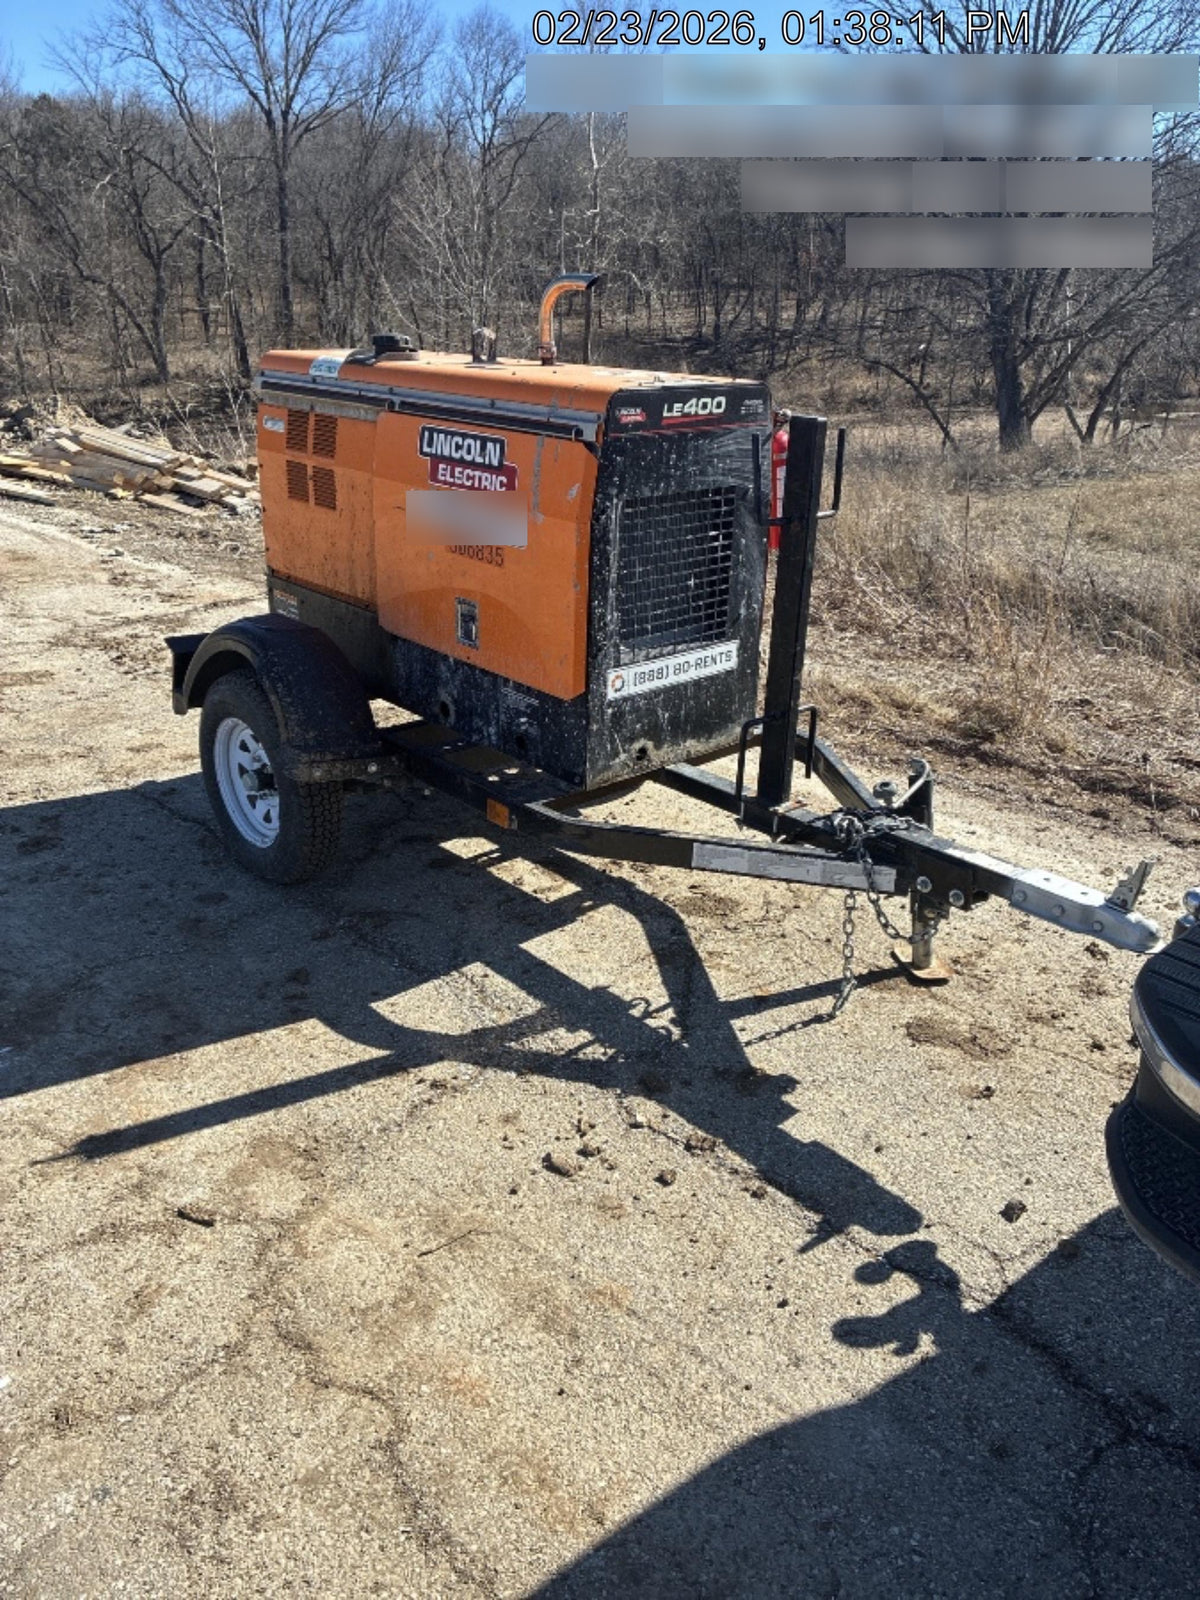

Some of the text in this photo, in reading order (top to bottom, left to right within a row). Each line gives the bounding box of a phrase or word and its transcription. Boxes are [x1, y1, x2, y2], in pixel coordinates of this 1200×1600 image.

[663, 396, 726, 418] LE400
[422, 430, 501, 467] LINCOLN
[438, 463, 507, 491] ELECTRIC
[634, 664, 669, 687] (888)
